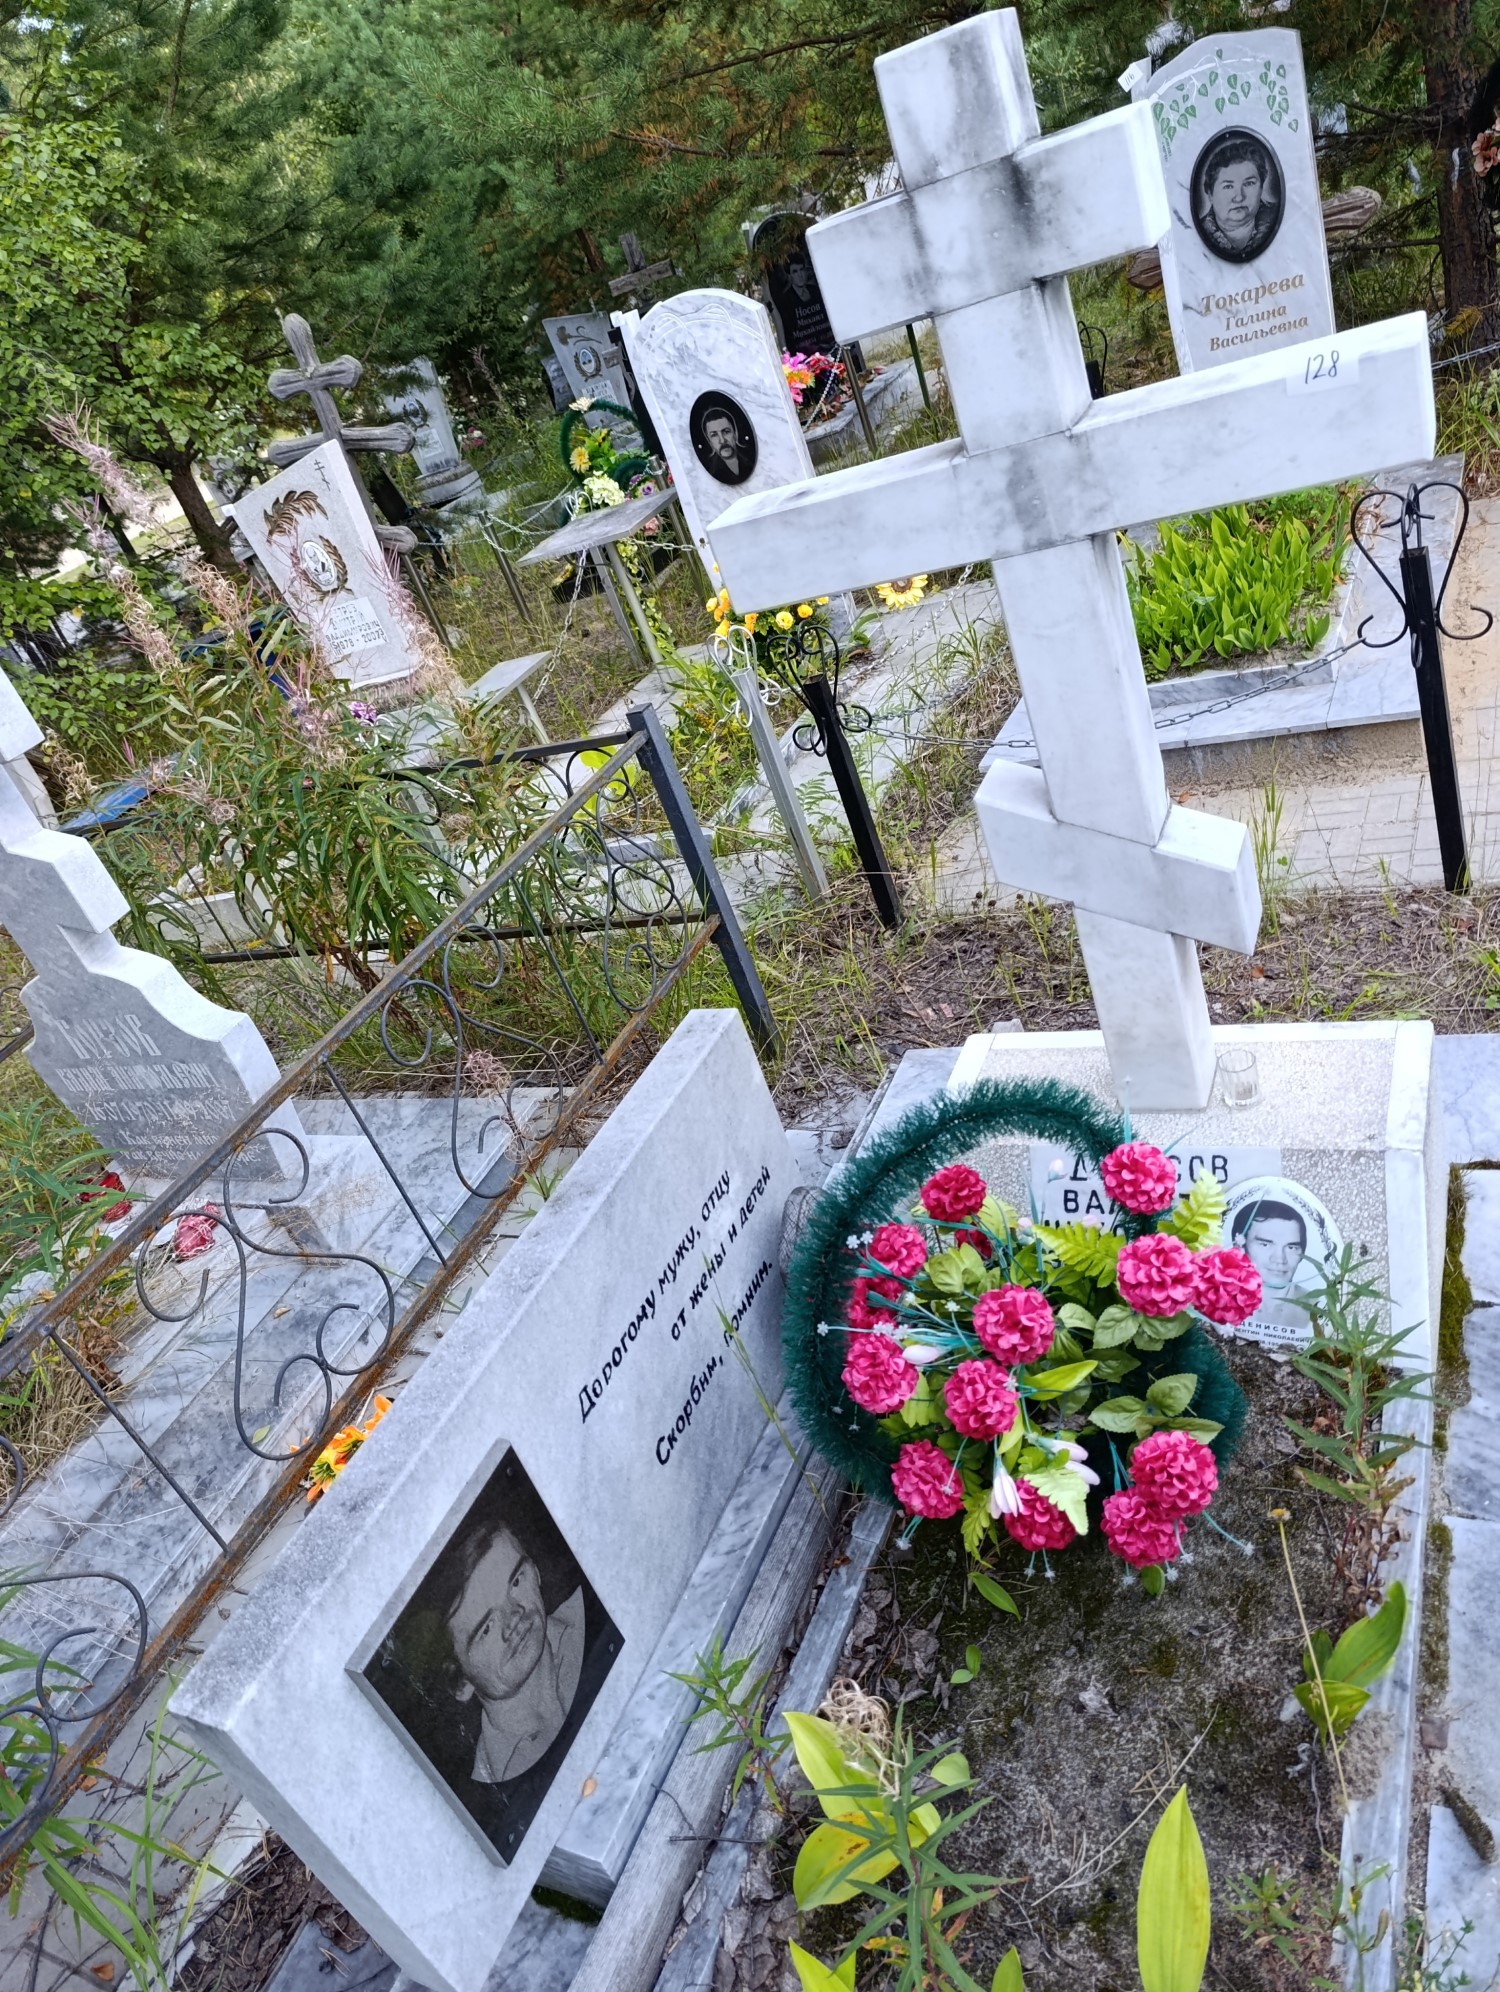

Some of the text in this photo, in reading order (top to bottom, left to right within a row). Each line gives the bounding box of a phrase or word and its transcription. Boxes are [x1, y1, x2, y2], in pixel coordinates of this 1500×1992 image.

[1201, 273, 1305, 315] Токарева
[1209, 315, 1309, 352] Васильевна
[1225, 305, 1287, 331] Галина
[1304, 350, 1340, 385] 128
[670, 1165, 771, 1342] от жены и детей
[577, 1170, 731, 1424] Дорогому мужу, отцу
[655, 1355, 724, 1466] Скорбим,
